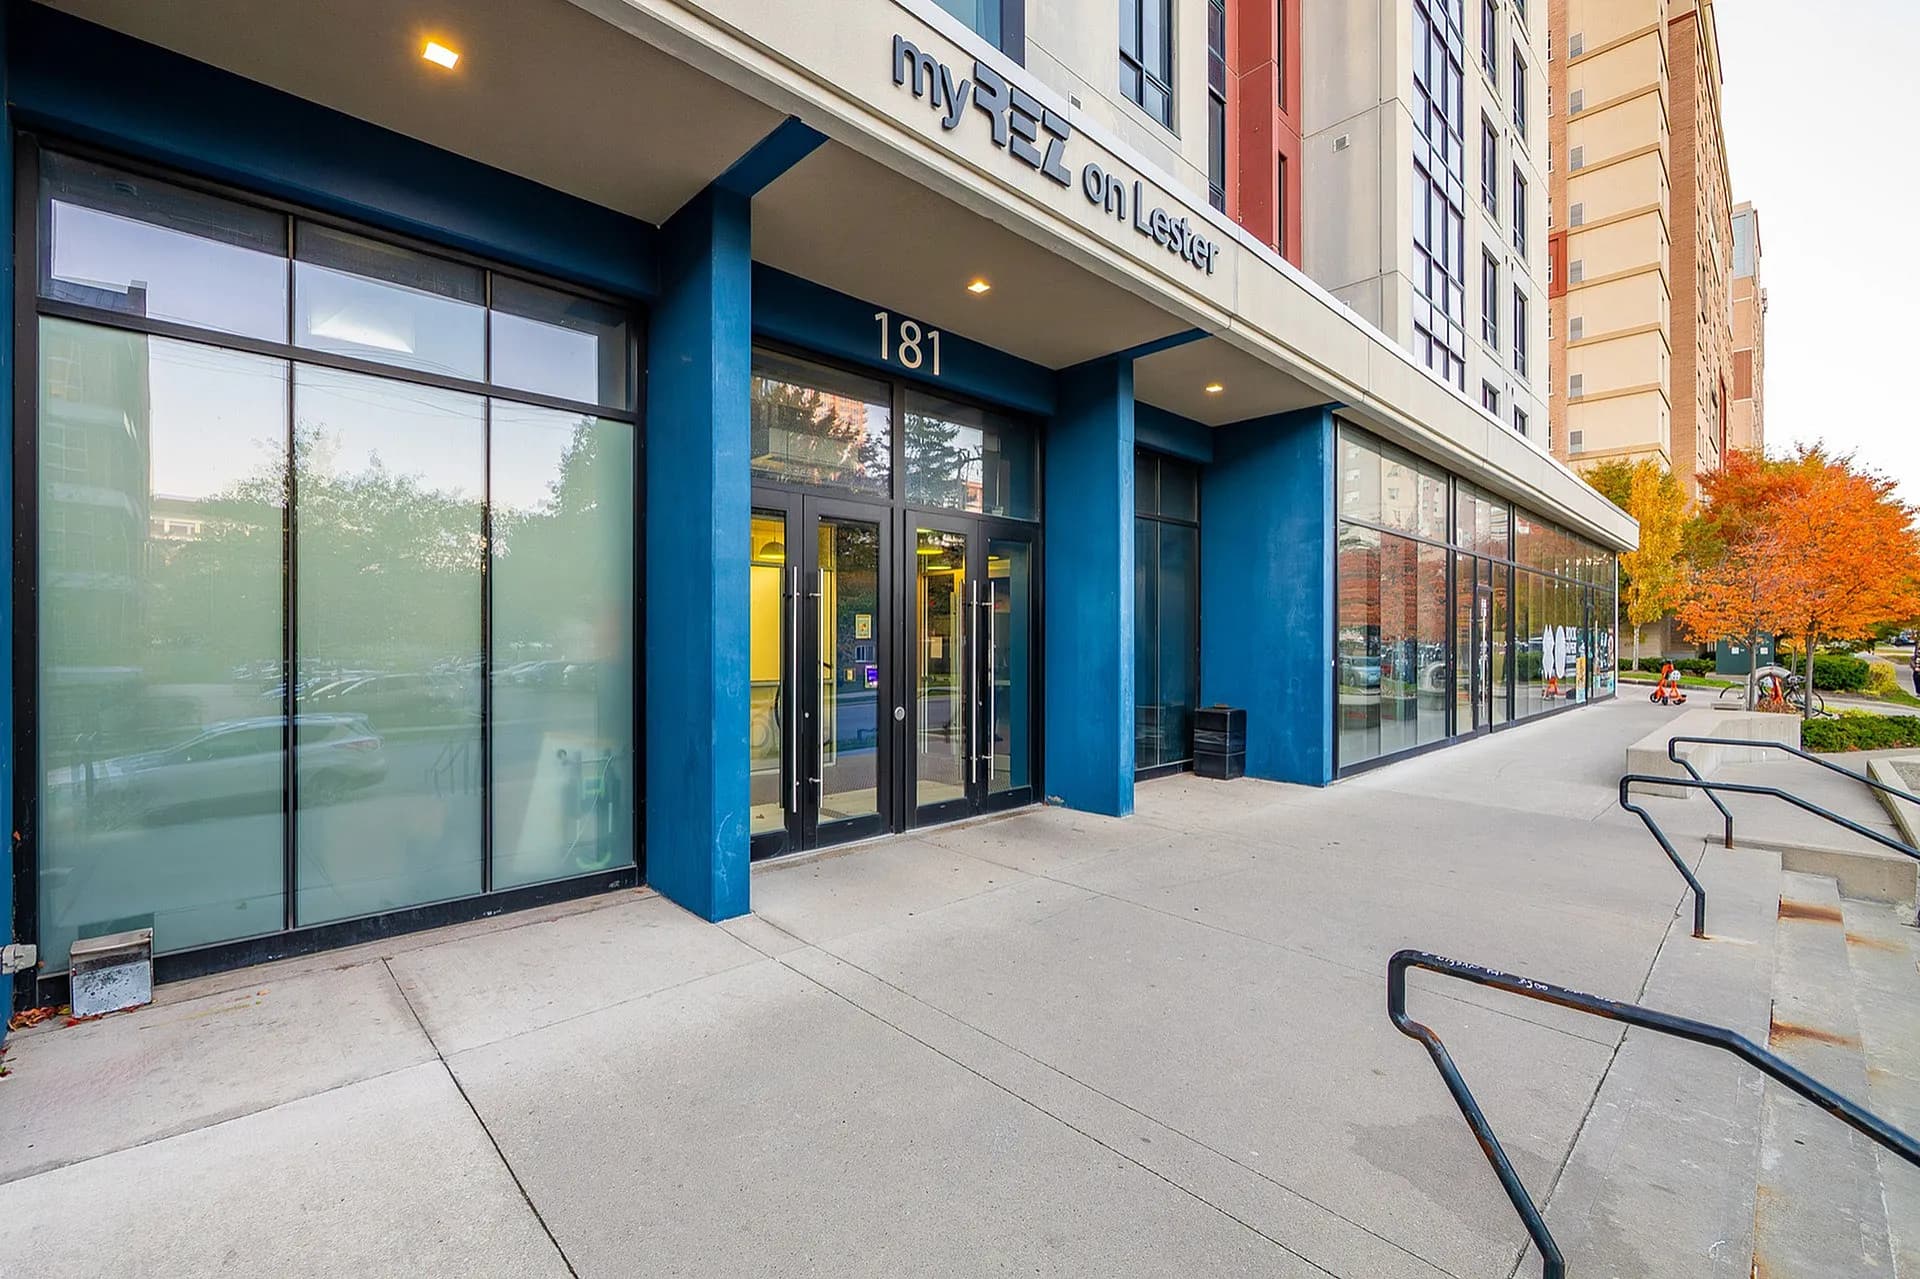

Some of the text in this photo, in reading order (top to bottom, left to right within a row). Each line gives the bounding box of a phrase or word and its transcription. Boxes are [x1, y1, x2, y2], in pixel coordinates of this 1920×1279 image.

[892, 33, 1220, 275] myREZ on Lester
[874, 311, 940, 376] 181
